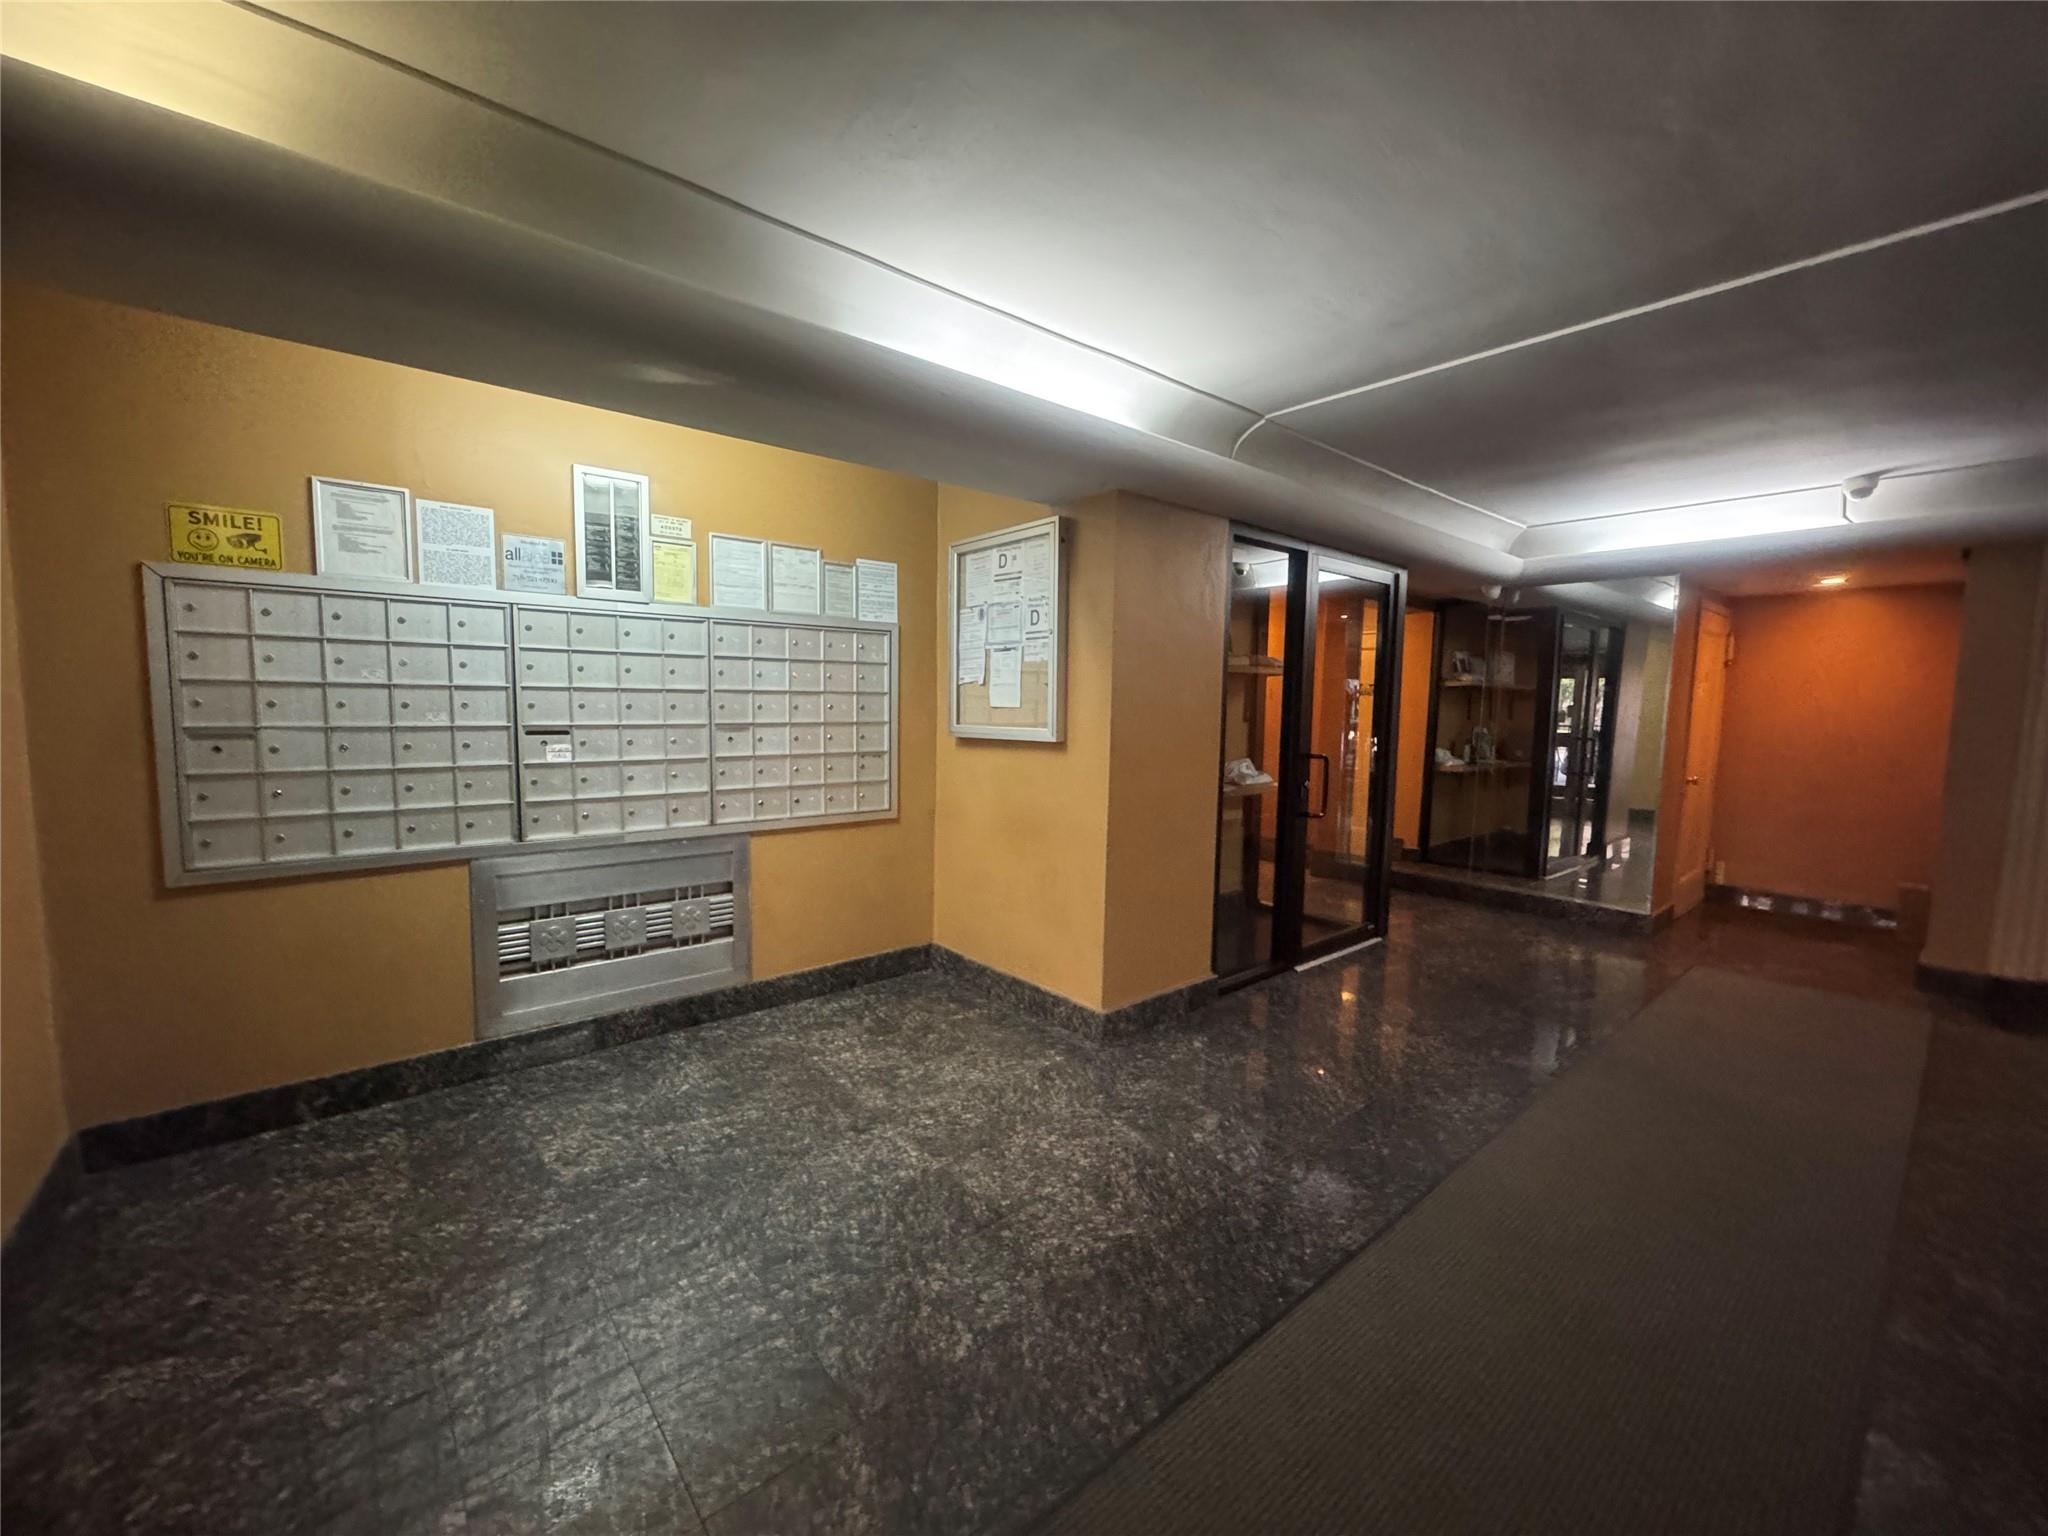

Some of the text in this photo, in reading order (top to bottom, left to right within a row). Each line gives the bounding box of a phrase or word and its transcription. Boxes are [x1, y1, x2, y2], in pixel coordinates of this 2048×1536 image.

[188, 510, 262, 531] SMILE!
[177, 550, 277, 567] YOU'RE ON CAMERA
